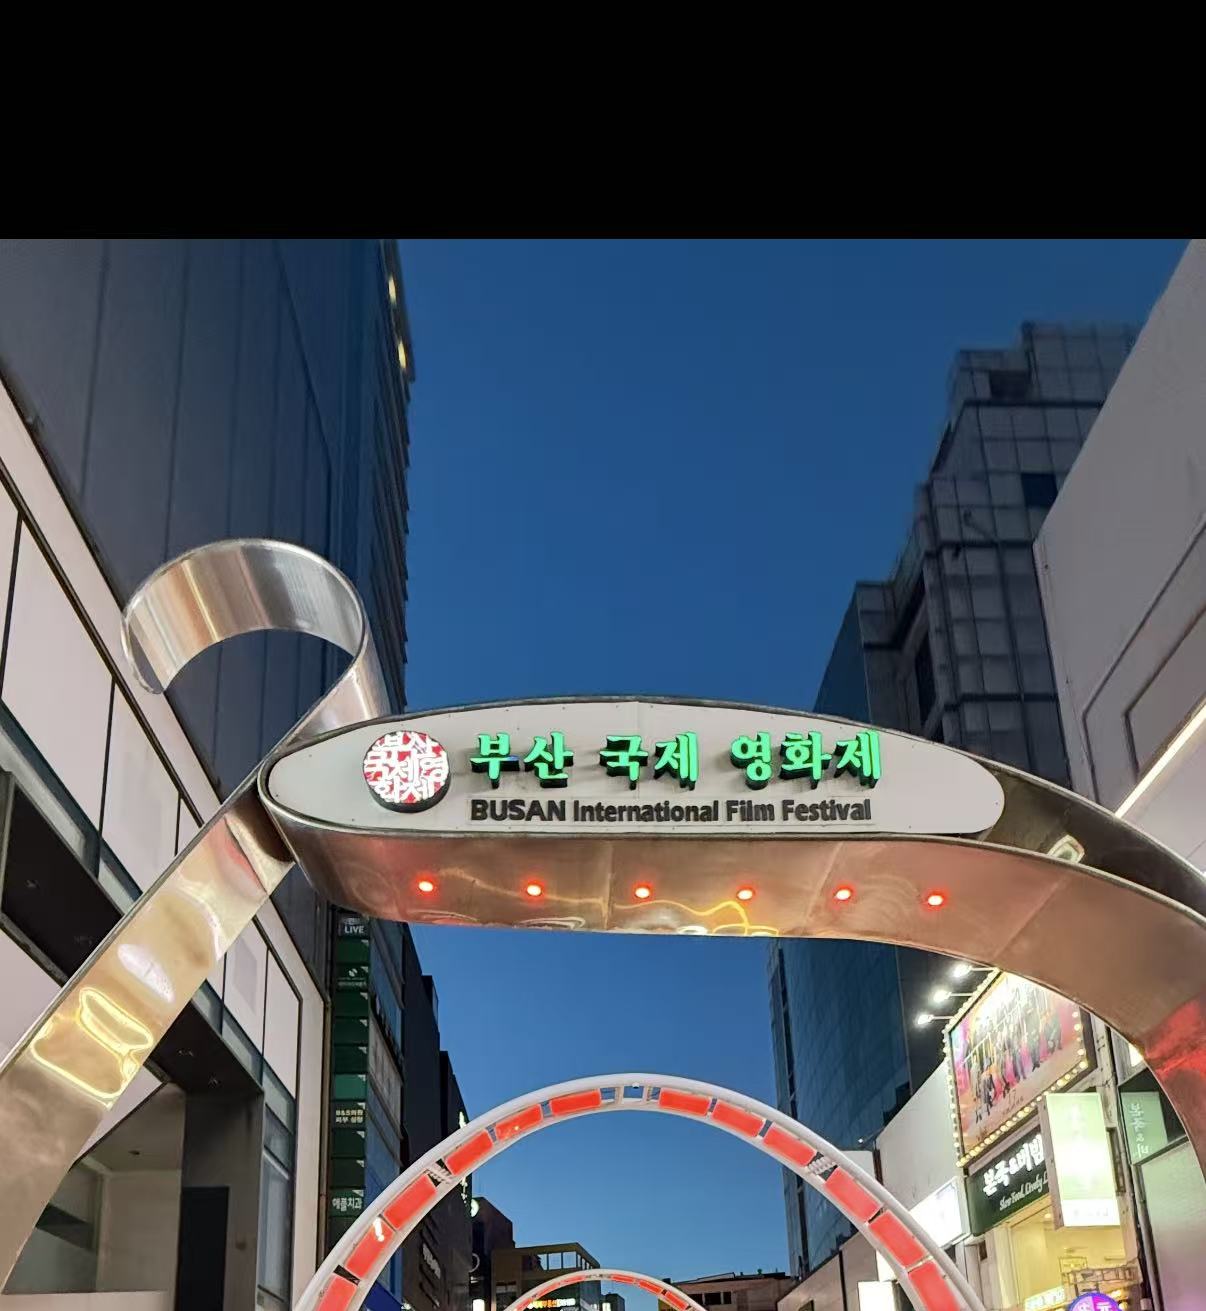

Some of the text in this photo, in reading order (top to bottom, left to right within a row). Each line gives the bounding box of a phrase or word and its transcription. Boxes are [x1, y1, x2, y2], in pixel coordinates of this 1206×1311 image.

[469, 730, 882, 790] 부산 국제 영화제
[470, 798, 872, 822] BUSAN International Film Festival
[344, 925, 365, 934] LIVE
